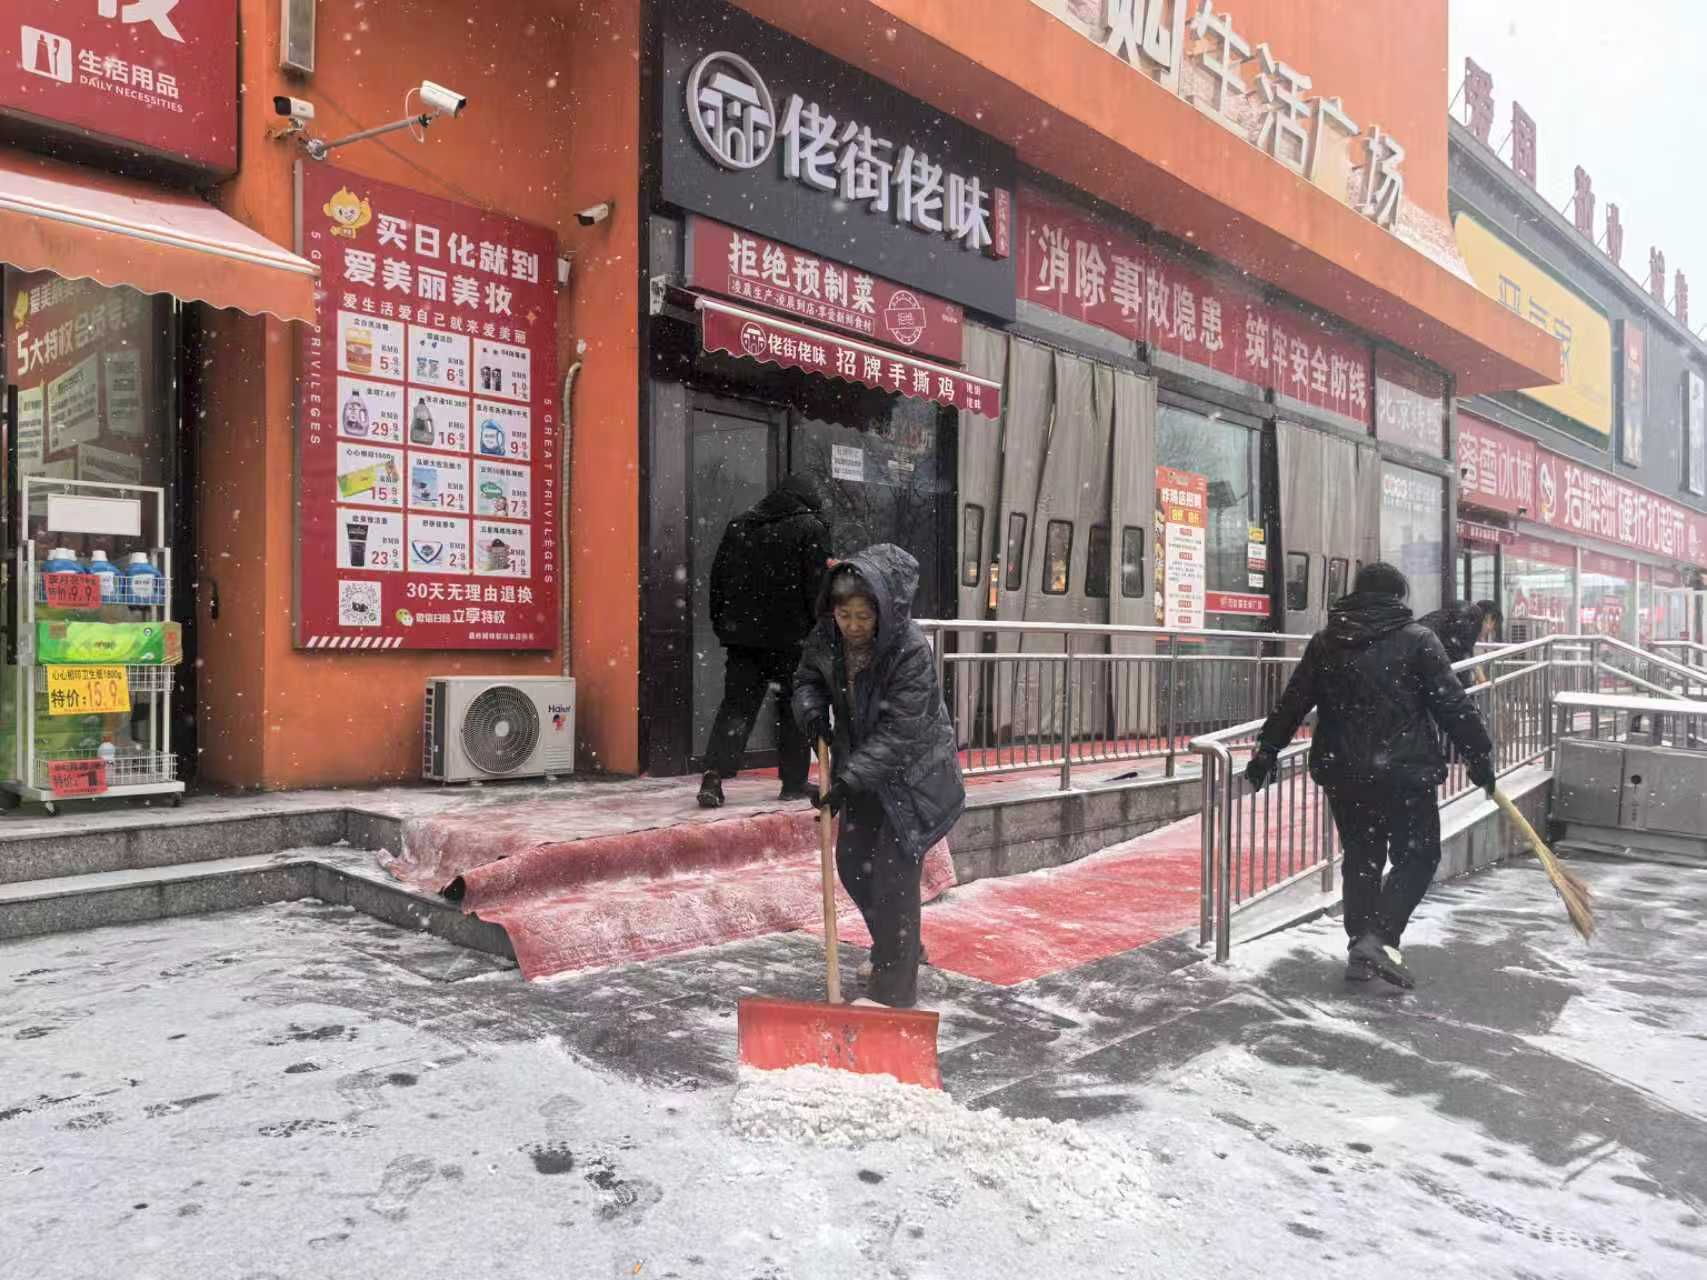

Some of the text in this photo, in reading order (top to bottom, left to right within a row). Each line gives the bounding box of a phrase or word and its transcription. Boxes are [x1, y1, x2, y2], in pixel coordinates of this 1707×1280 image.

[78, 49, 179, 99] 生活用品
[80, 74, 183, 113] DAILY NECESSITIES
[779, 93, 992, 250] 佬街佬味
[377, 212, 539, 284] 买日化就到
[727, 231, 876, 314] 拒绝预制菜
[343, 248, 513, 317] 爱美丽美妆
[1037, 223, 1367, 409] 消除事故隐患 筑牢安全防线
[343, 293, 527, 344] 爱生活爱自己就来爱美丽
[768, 333, 955, 401] 佬街佬味 招牌手撕鸡
[544, 414, 552, 470] GREAT
[1457, 428, 1533, 506] 蜜雪冰城
[544, 479, 552, 583] PRIVILEGES
[406, 582, 533, 604] 30天无理由退换
[452, 607, 506, 624] 立享特权
[548, 704, 571, 713] Haier
